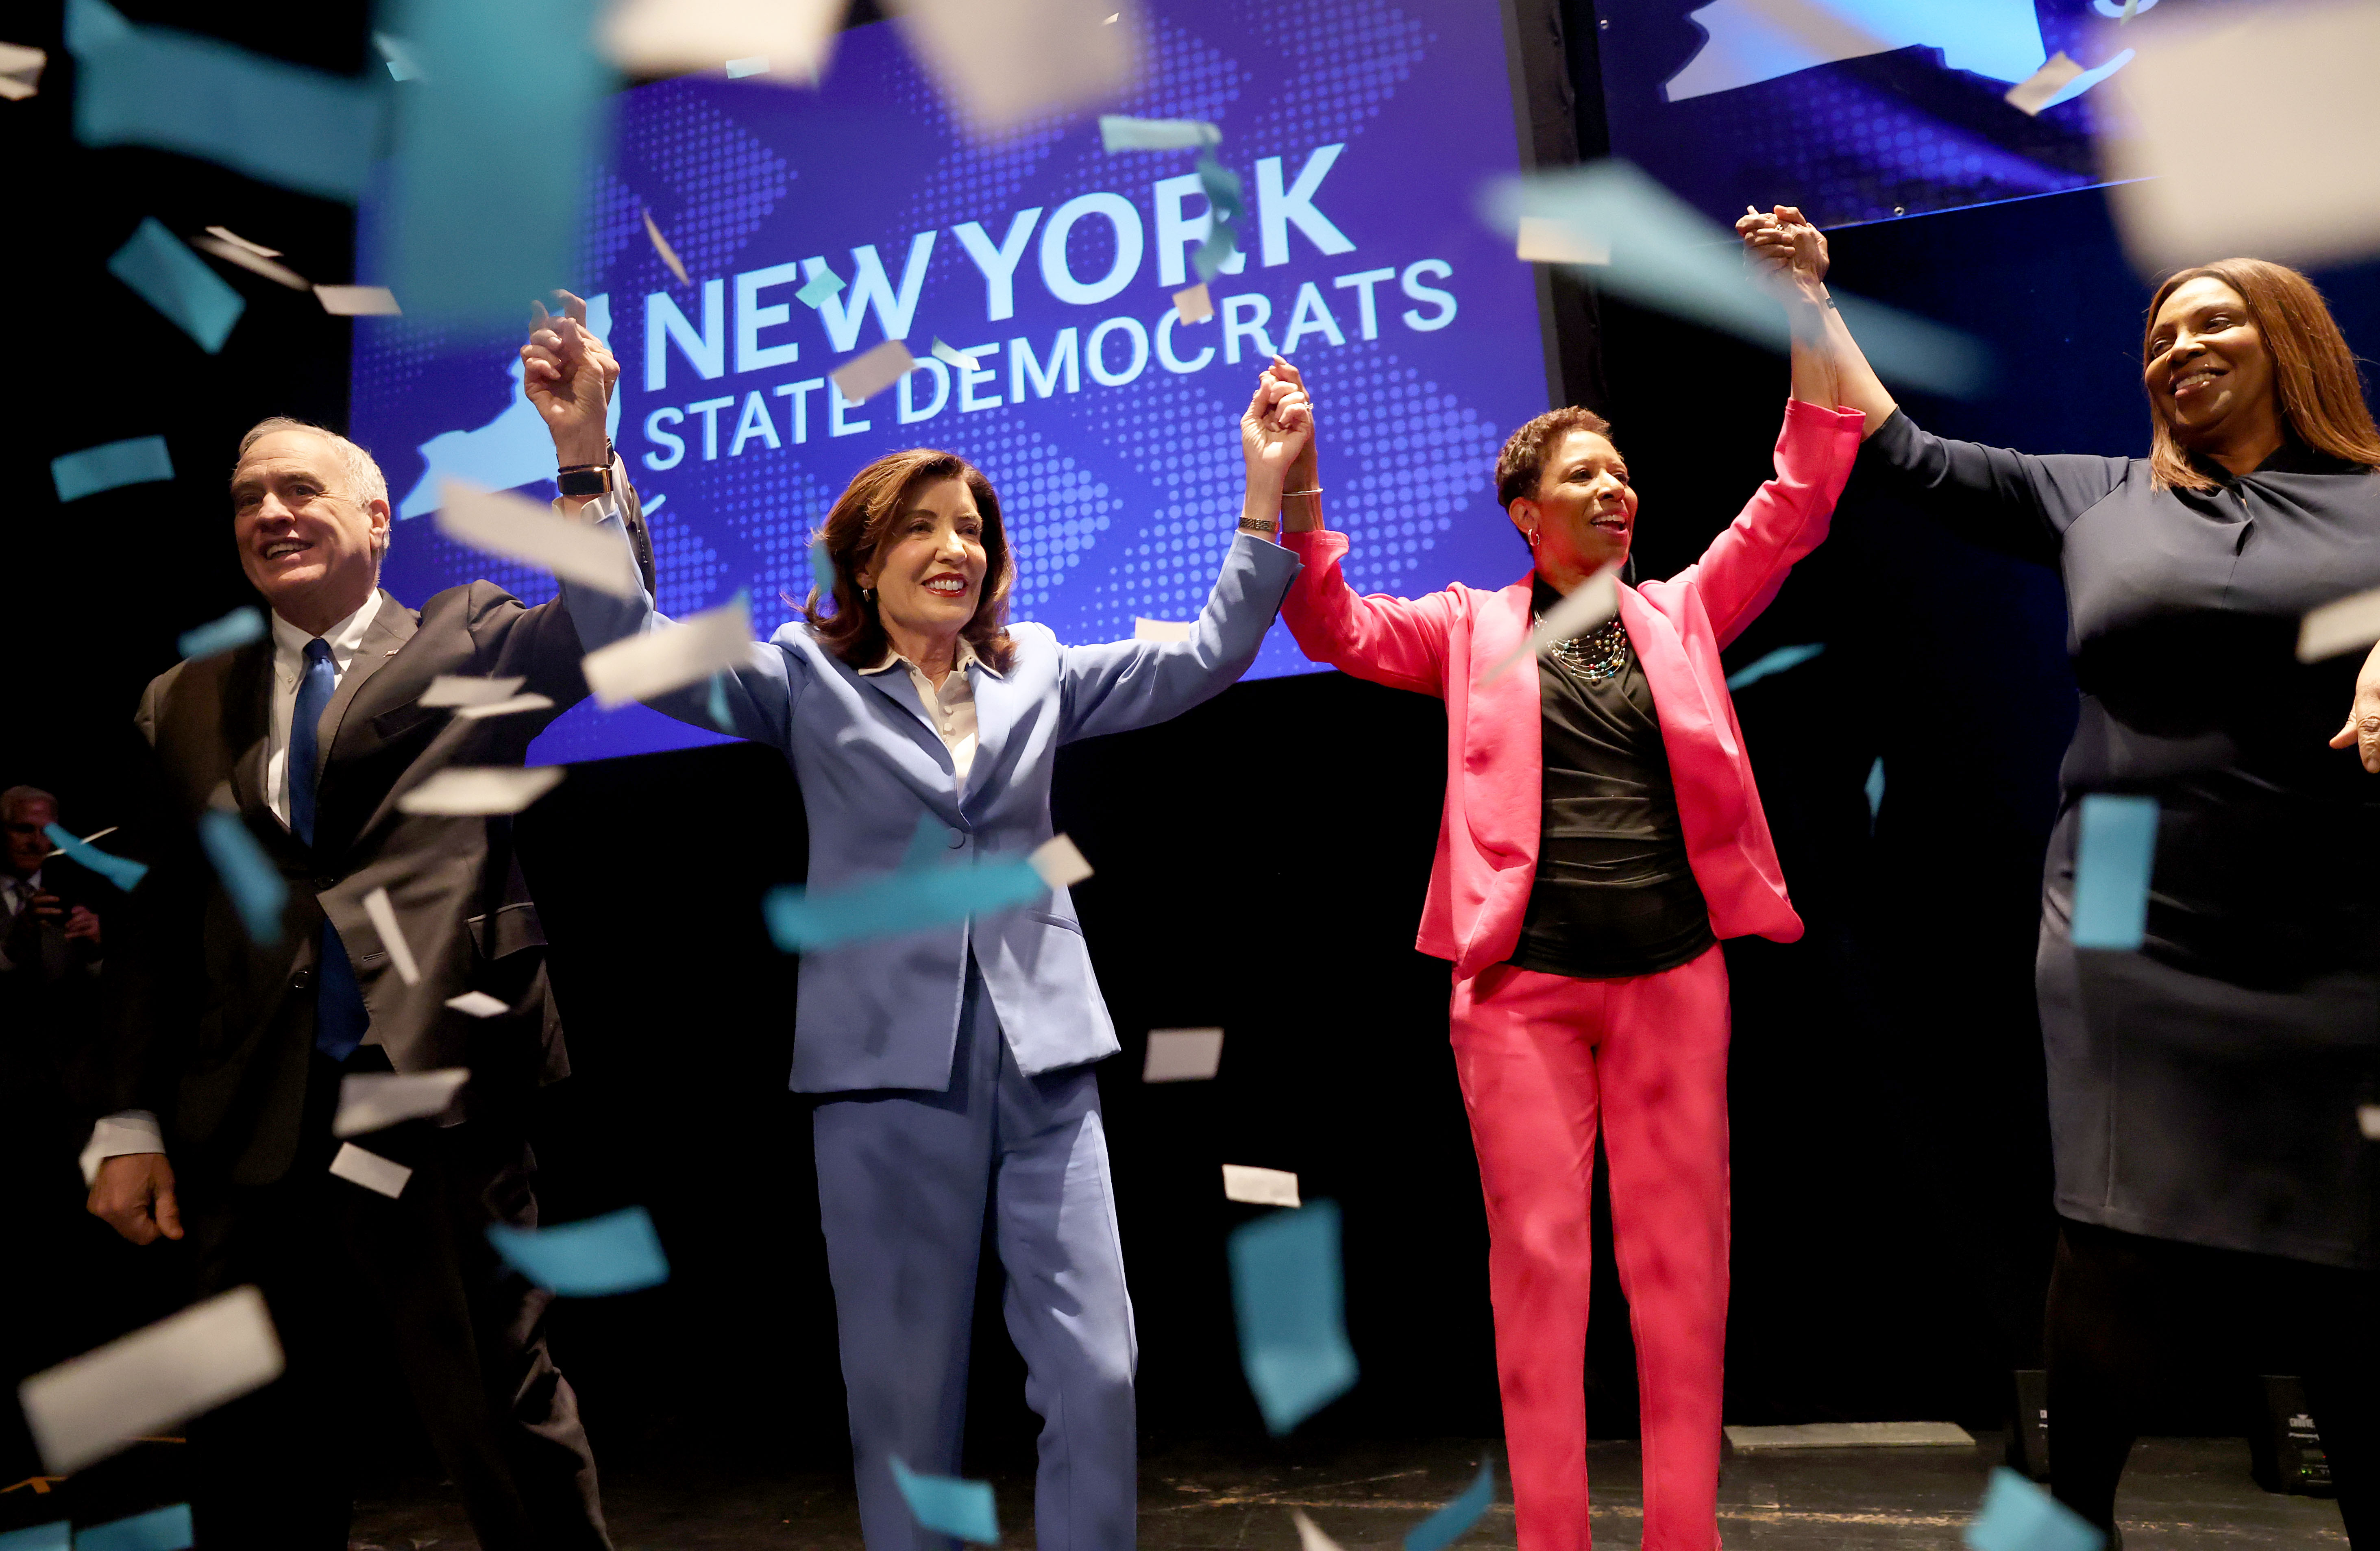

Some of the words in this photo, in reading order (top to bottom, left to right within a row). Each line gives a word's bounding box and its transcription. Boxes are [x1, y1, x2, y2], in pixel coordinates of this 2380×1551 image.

[642, 372, 871, 471] STATE
[897, 259, 1458, 425] DEMOCRATS
[644, 231, 936, 392] NEW
[951, 143, 1357, 321] YORK
